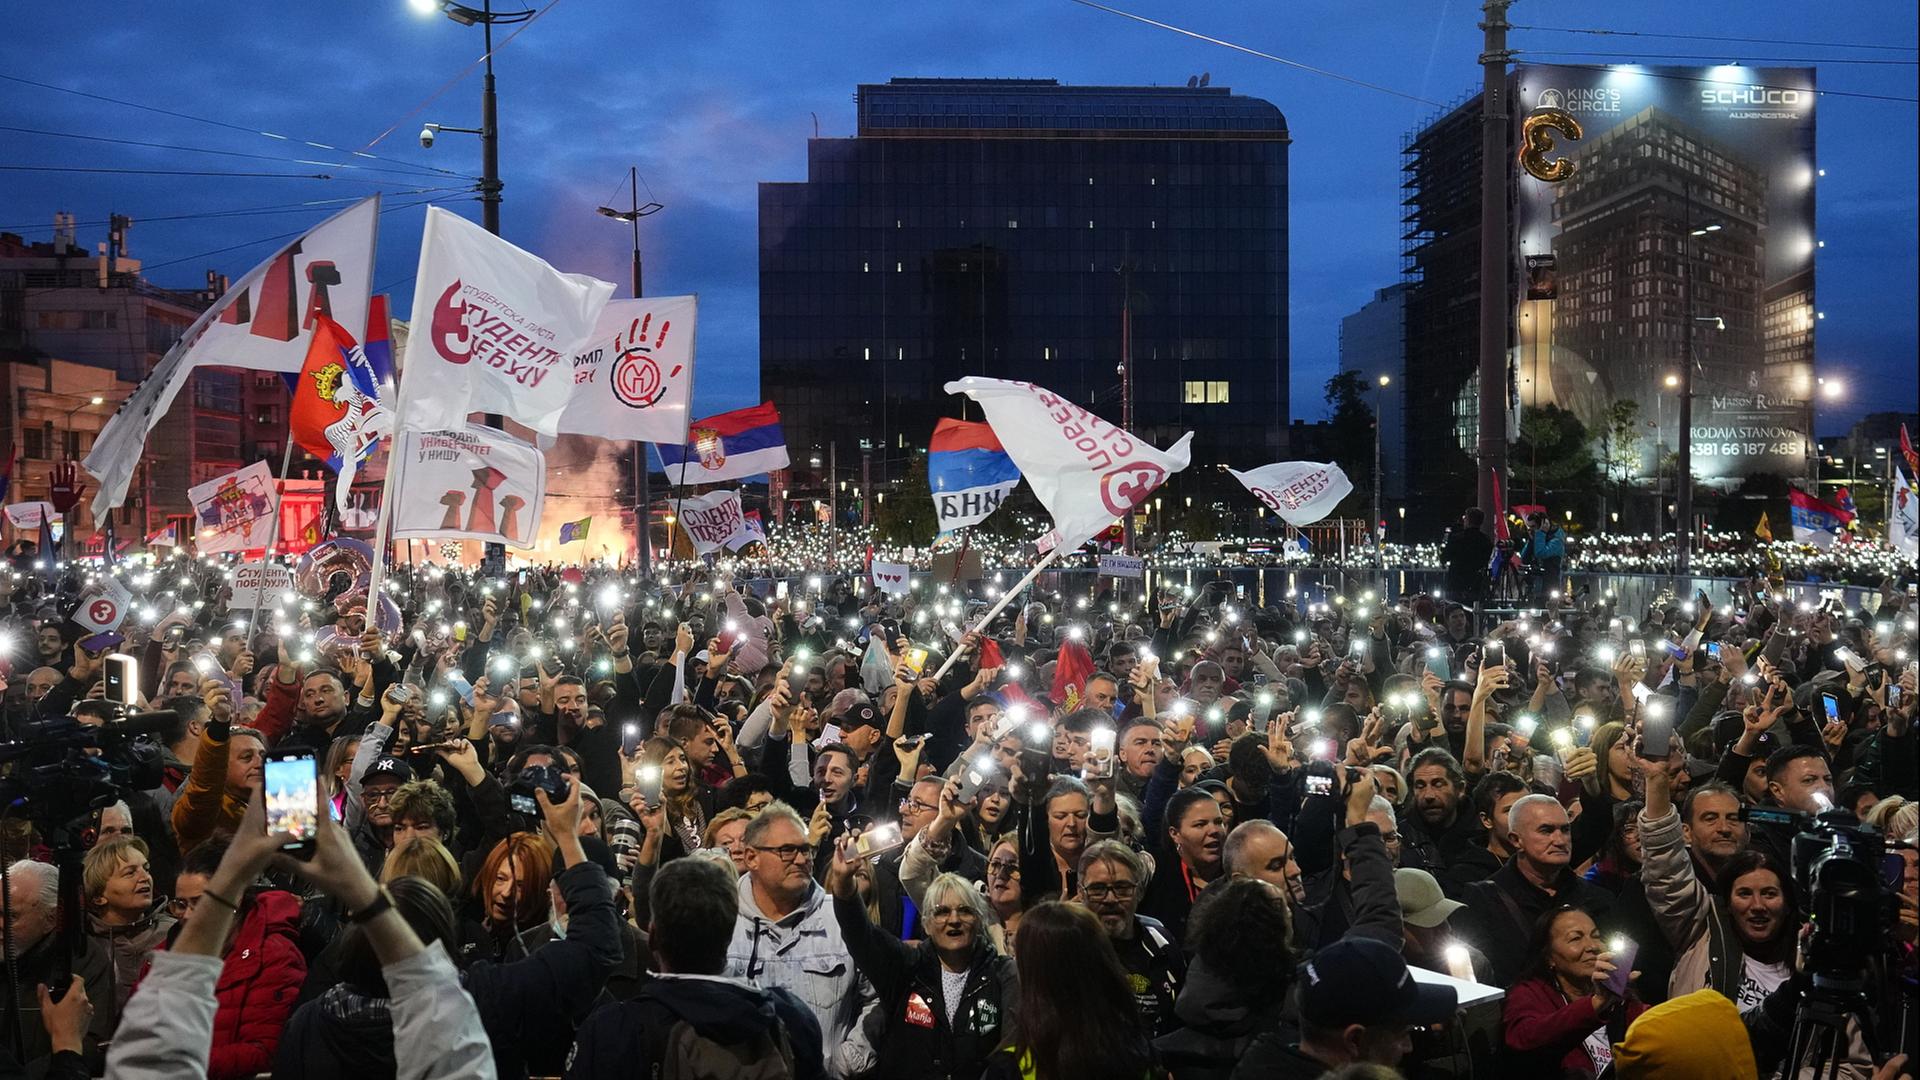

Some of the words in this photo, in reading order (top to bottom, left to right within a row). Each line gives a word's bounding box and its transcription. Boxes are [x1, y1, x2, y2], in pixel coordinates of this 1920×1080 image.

[1567, 88, 1620, 100] KING'S
[1701, 85, 1799, 104] SCHÜCO
[1567, 101, 1621, 111] CIRCLE
[462, 284, 525, 325] СТУДЕНТСКА
[524, 321, 556, 342] ЛИСТА
[1690, 427, 1737, 440] RODAJA
[1739, 427, 1798, 439] STANOVA
[1721, 443, 1740, 455] 66
[1743, 443, 1766, 455] 187
[1769, 443, 1797, 455] 485
[428, 449, 460, 463] НИШУ
[94, 603, 112, 620] 3
